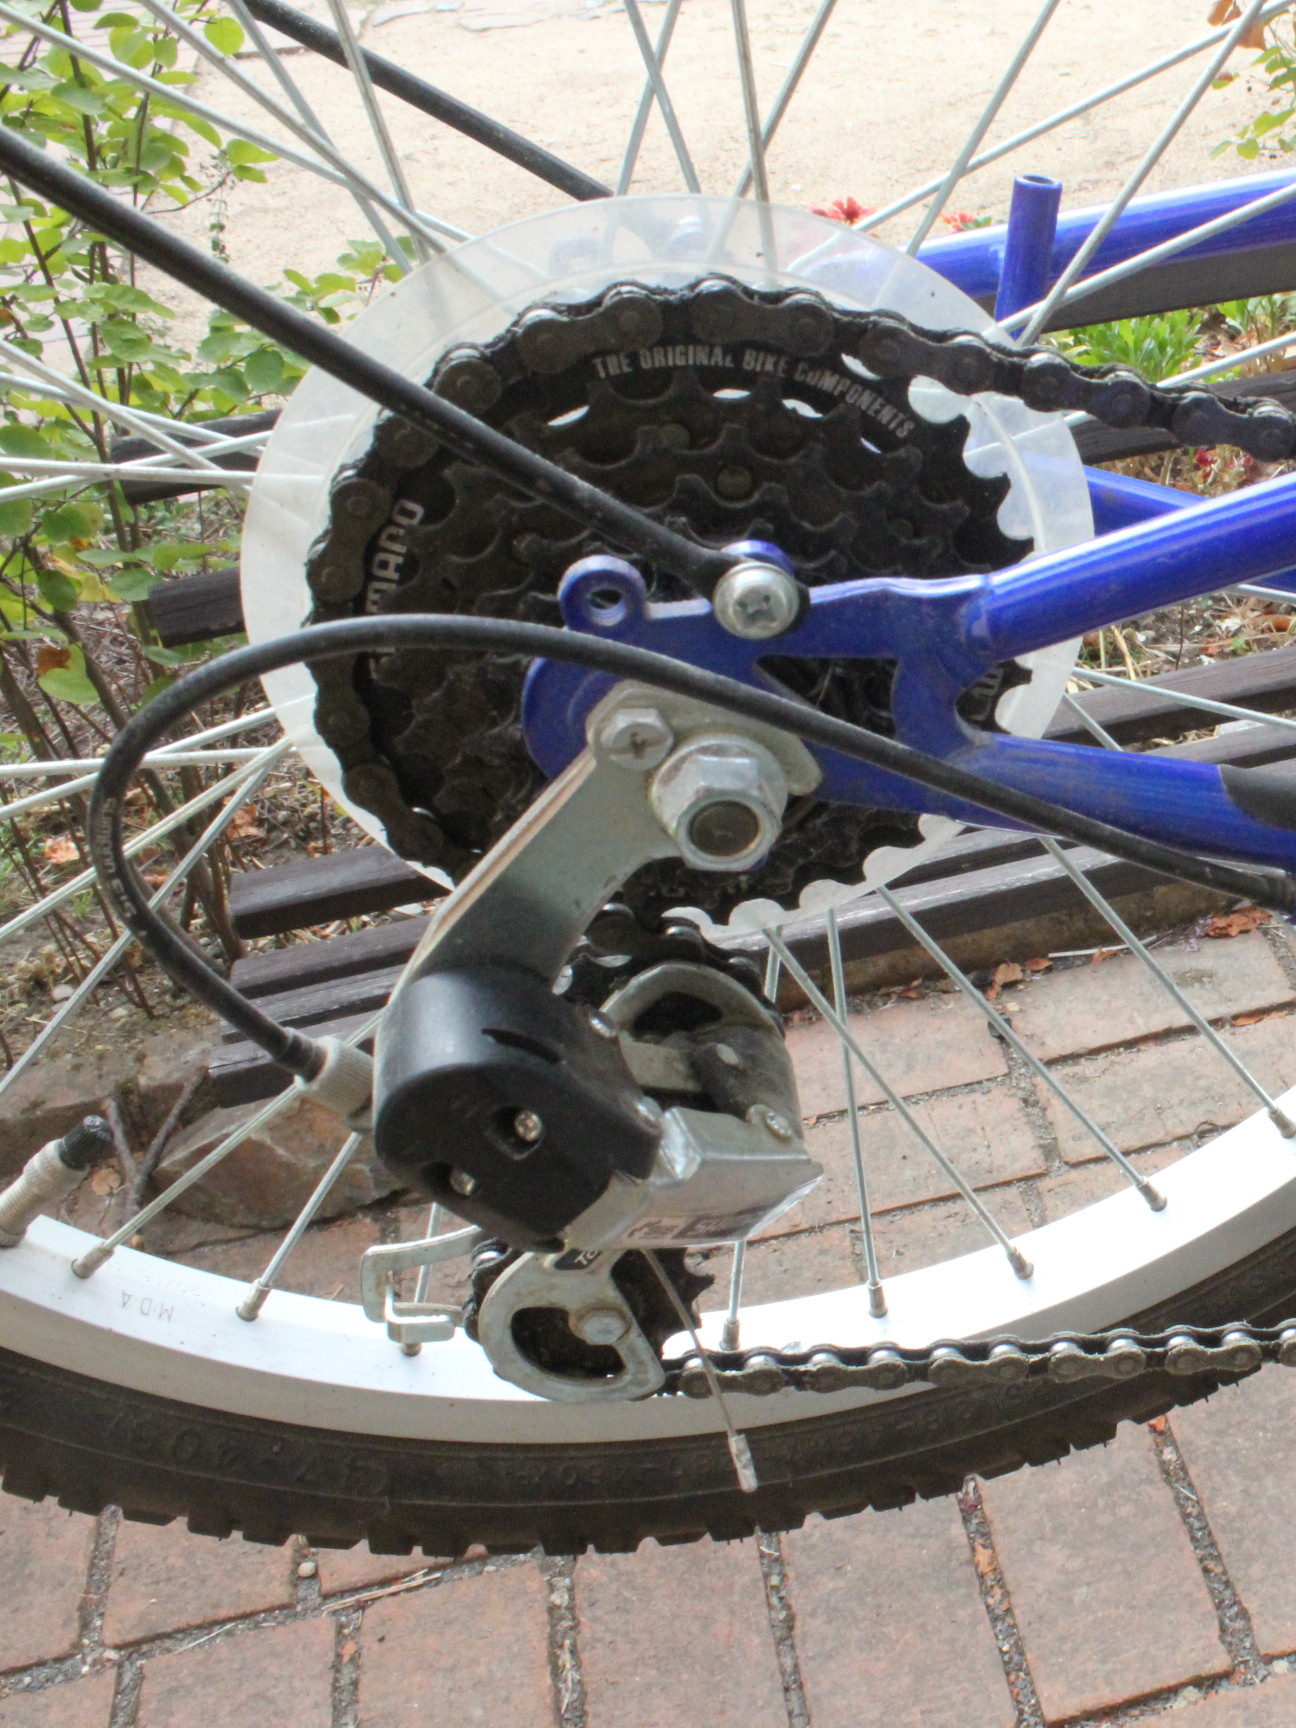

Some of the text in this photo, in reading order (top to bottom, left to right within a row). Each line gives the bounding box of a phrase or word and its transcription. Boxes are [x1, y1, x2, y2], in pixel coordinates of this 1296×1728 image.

[592, 345, 915, 438] THE ORIGINAL BIKE COMPONENTS
